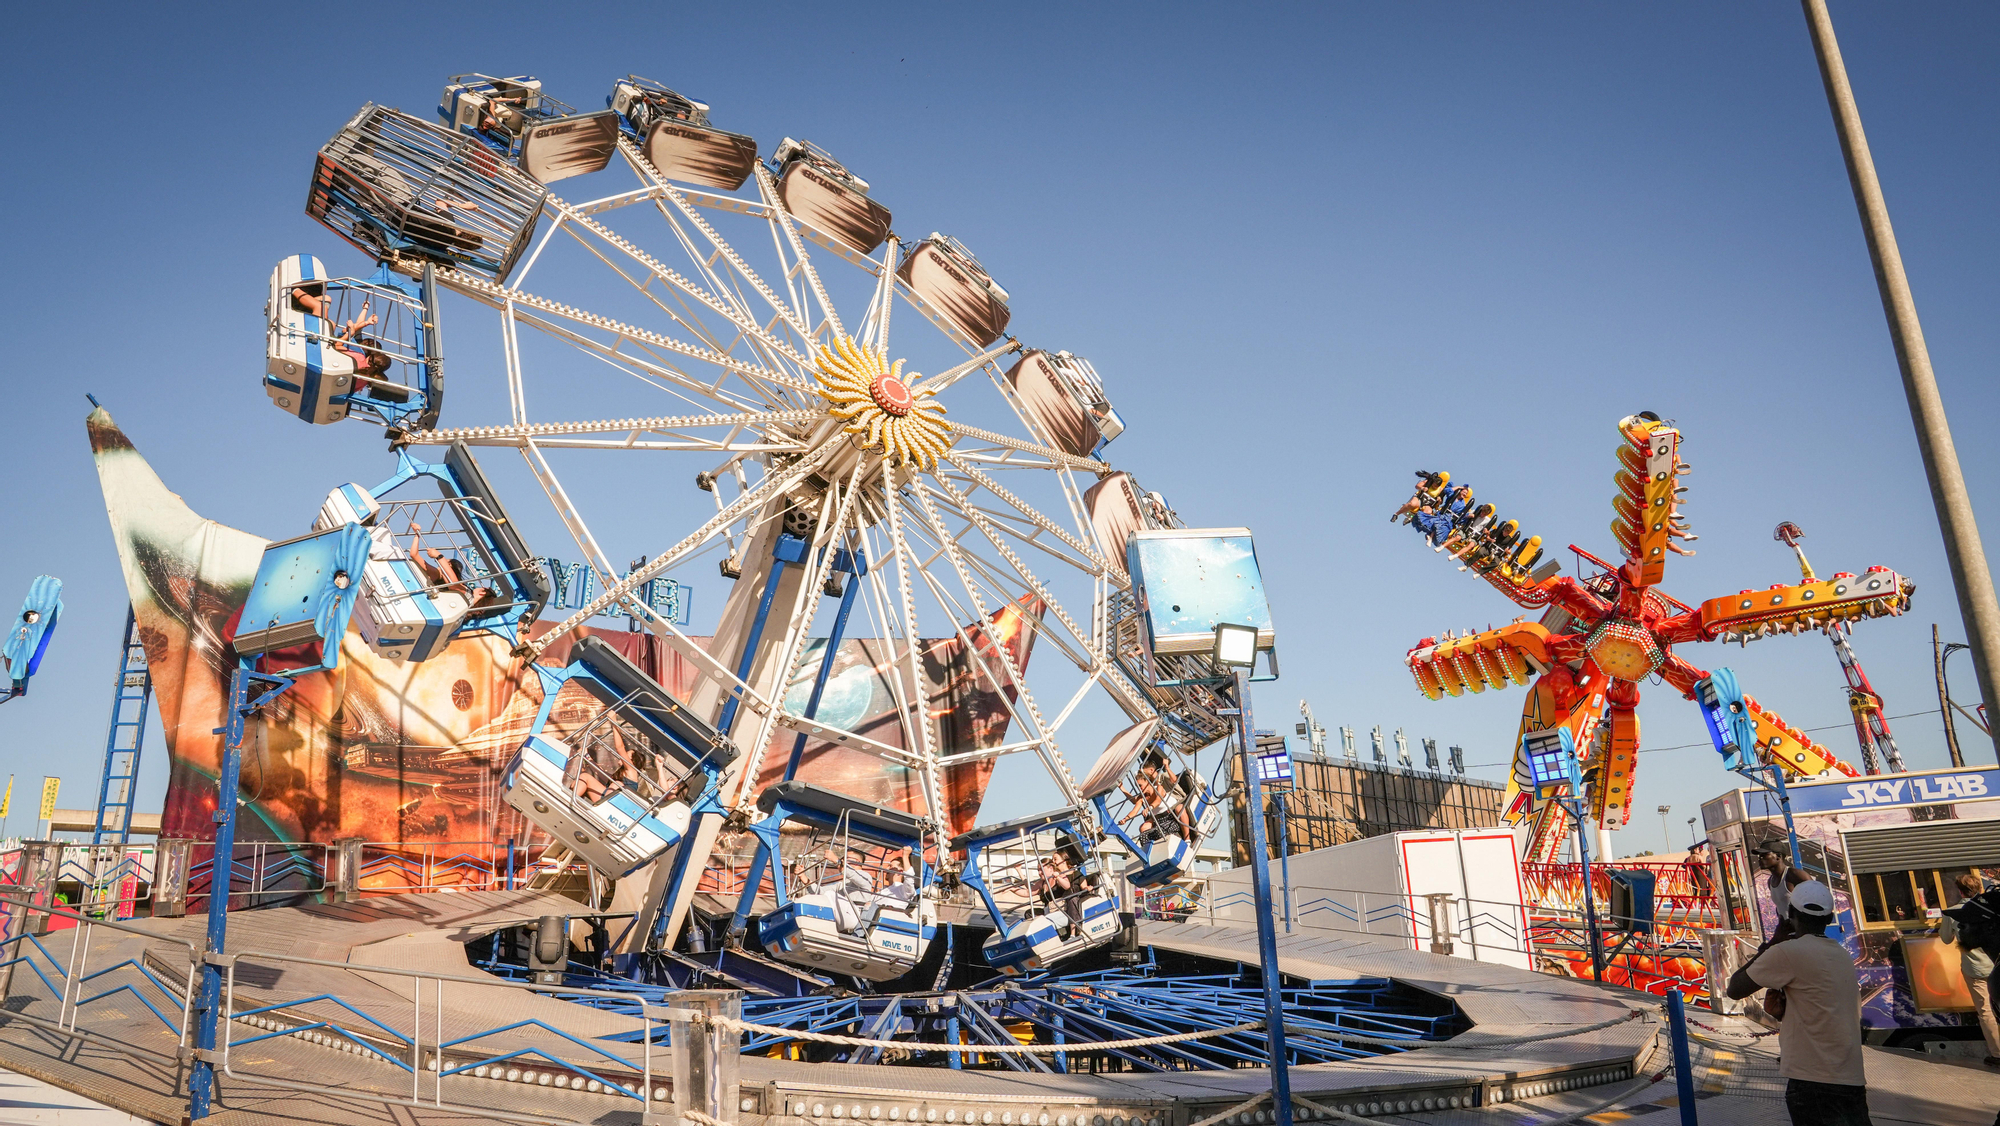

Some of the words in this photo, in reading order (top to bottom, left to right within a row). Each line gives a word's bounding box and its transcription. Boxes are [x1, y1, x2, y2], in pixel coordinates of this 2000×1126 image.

[1841, 779, 1907, 807] SKY
[1913, 774, 1988, 801] LAB
[630, 831, 638, 839] 9
[1091, 923, 1104, 933] NAVE
[881, 939, 902, 950] NAVE
[904, 944, 912, 952] 10
